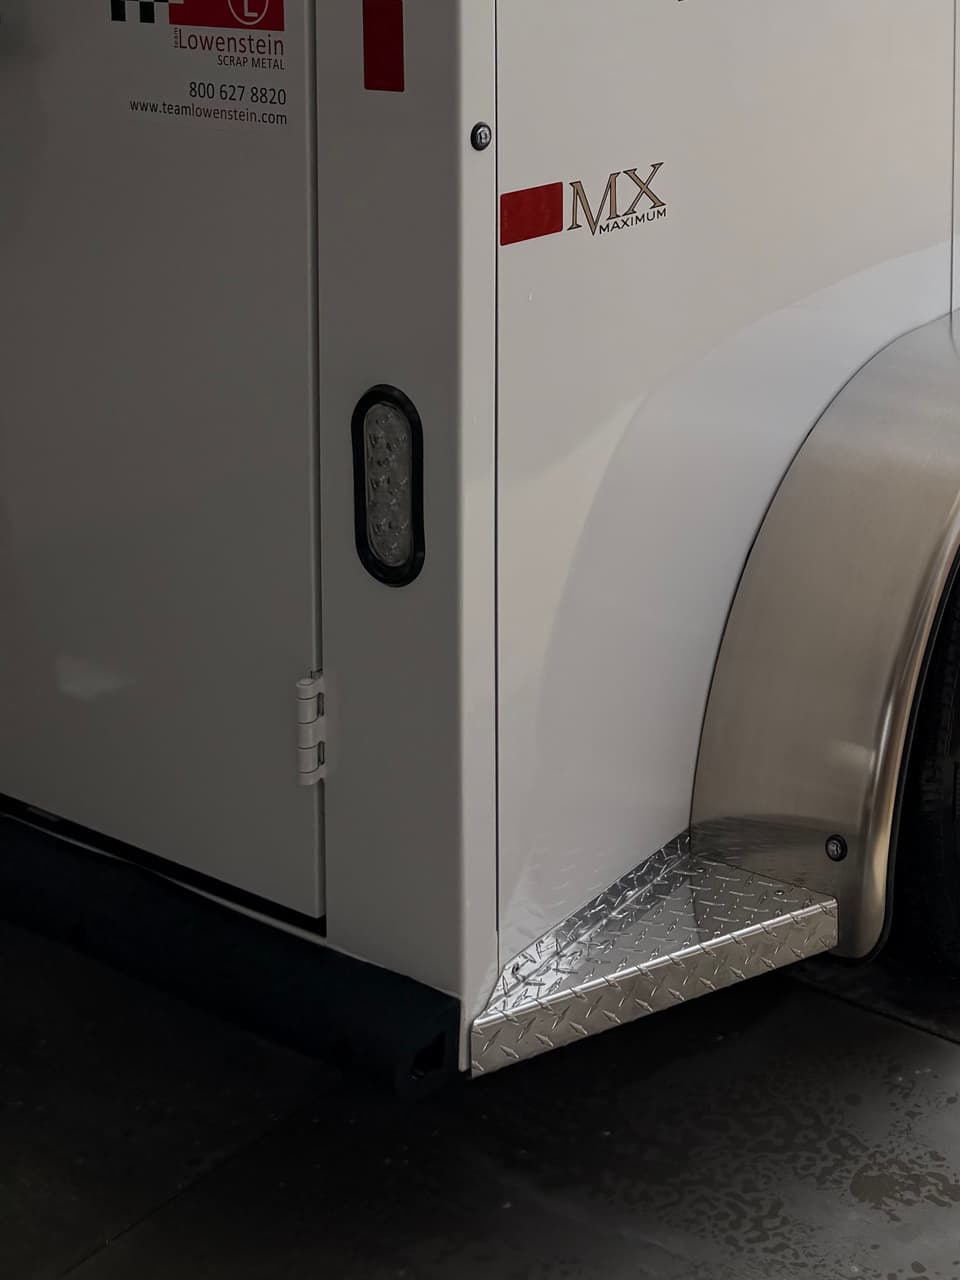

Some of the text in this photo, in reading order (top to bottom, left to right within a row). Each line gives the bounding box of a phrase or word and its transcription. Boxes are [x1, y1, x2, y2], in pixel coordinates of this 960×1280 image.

[179, 29, 284, 56] Lowenstein
[217, 54, 285, 70] SCRAP METAL
[189, 81, 287, 105] 800 627 8820
[129, 100, 287, 125] www.teamlowenstein.com
[567, 162, 666, 236] MX
[599, 207, 667, 235] MAXIMUM
